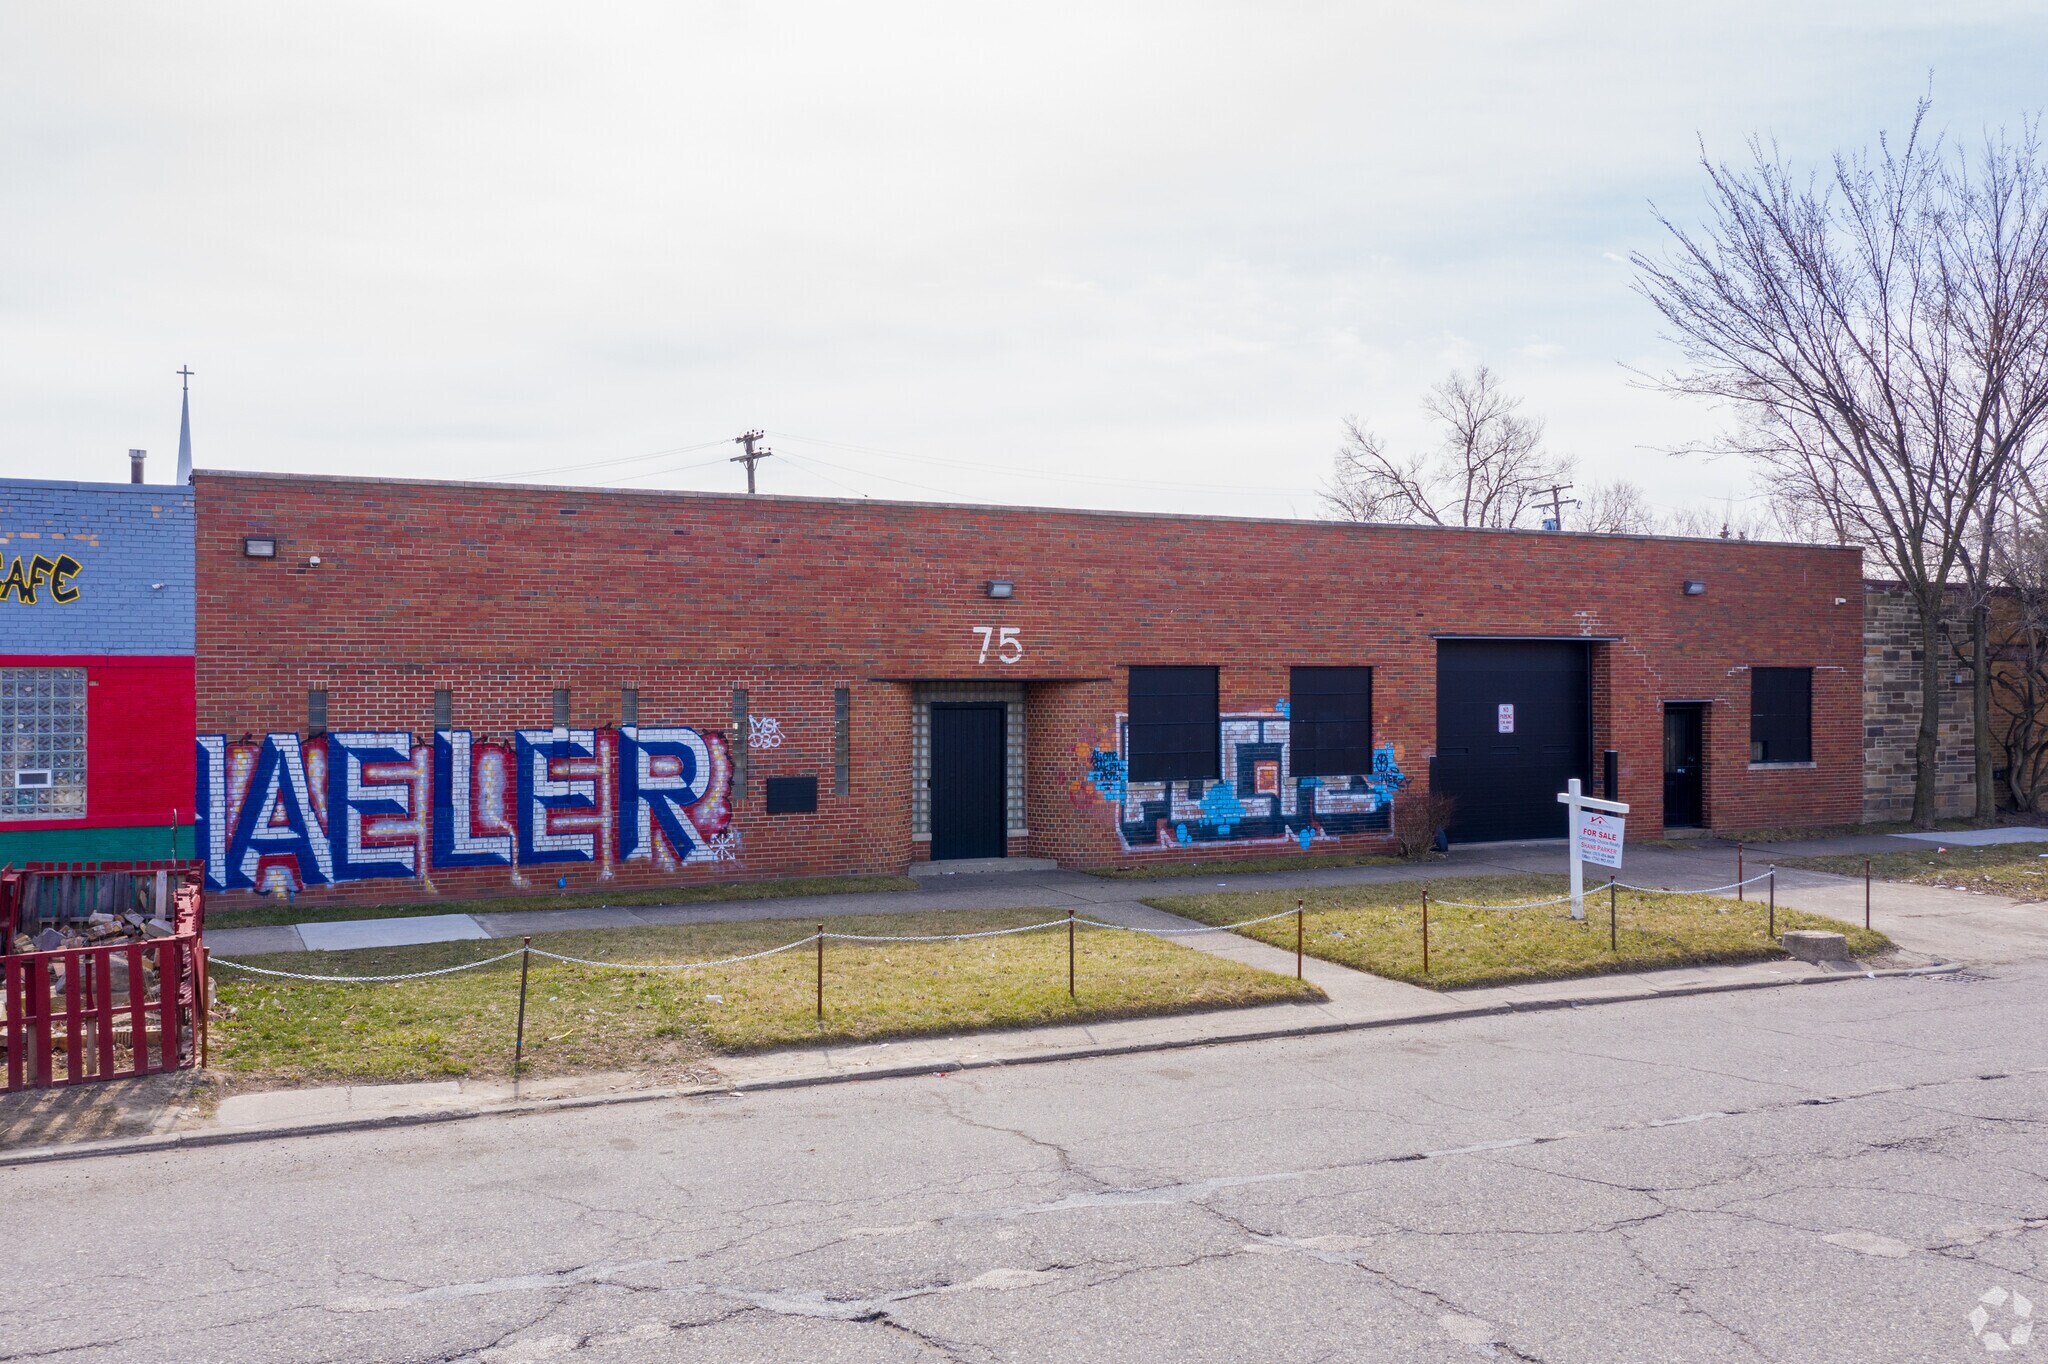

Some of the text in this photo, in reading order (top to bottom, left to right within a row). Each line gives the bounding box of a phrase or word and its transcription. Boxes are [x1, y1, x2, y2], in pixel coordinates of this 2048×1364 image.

[0, 552, 83, 605] AFE
[972, 626, 1023, 665] 75
[1583, 828, 1617, 841] FOR SALE
